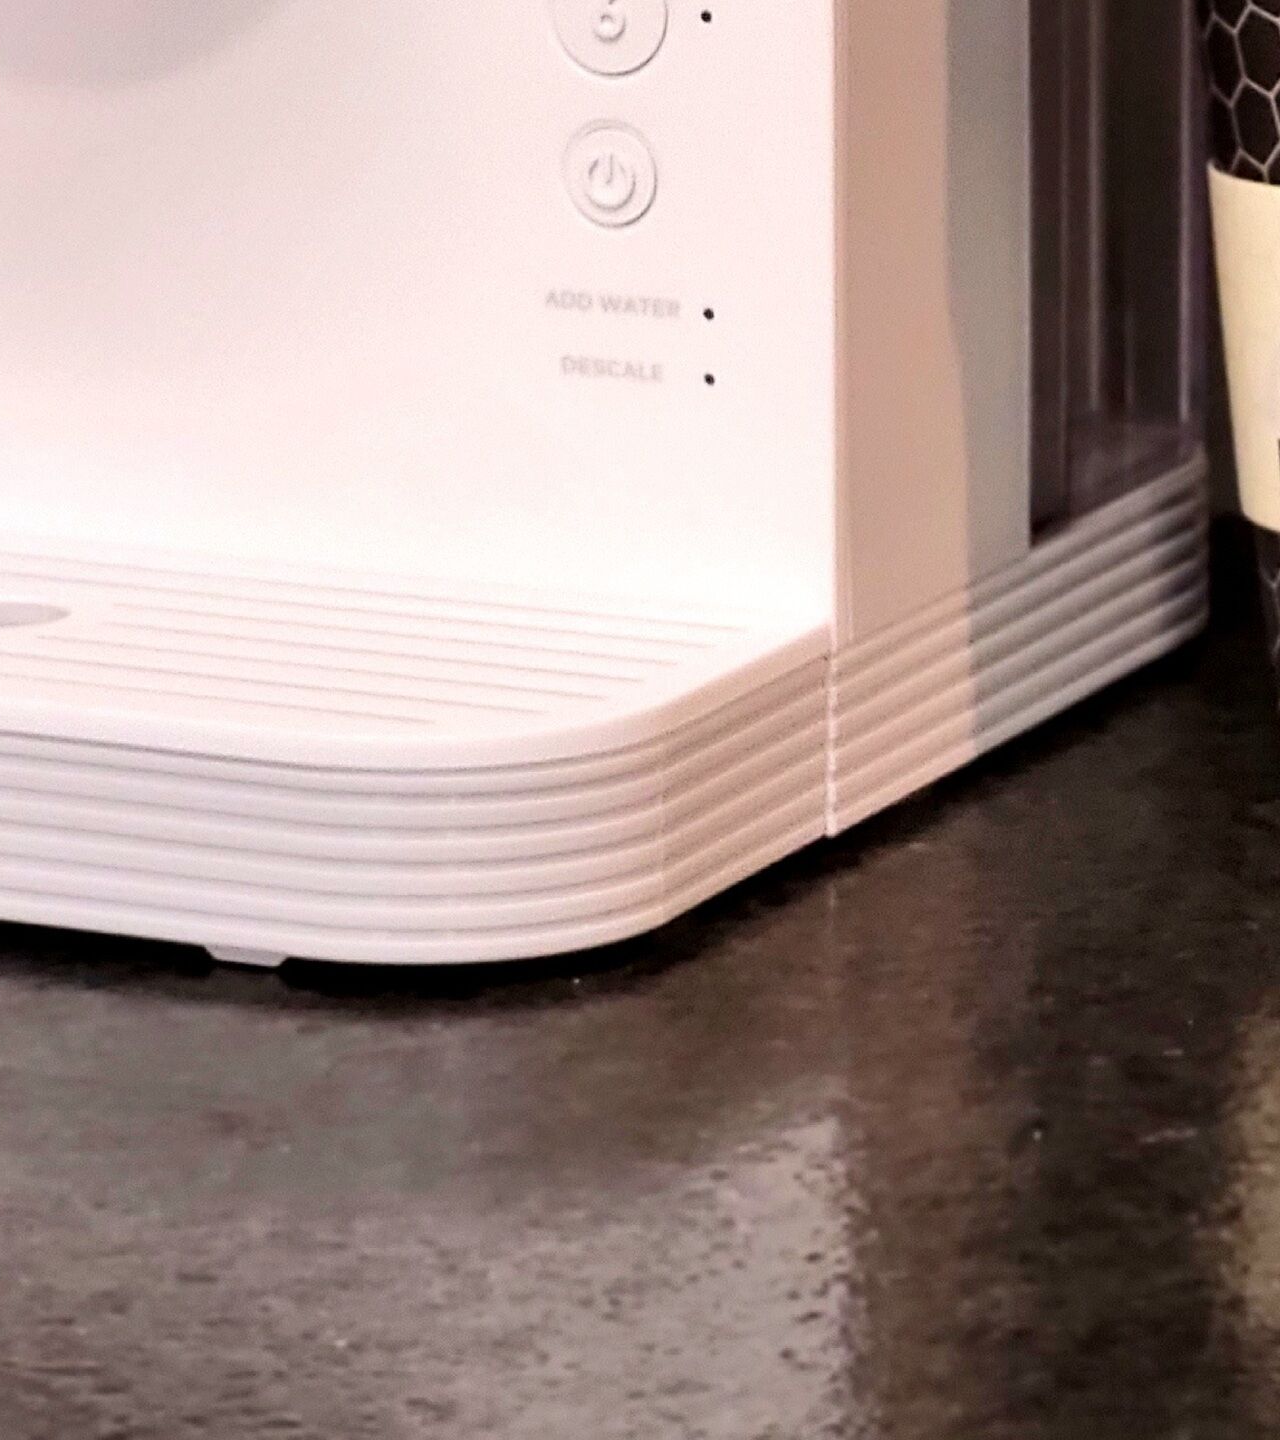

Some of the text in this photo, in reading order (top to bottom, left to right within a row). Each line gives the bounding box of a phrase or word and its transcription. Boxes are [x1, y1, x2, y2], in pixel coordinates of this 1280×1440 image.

[545, 289, 681, 319] ADD WATER
[560, 355, 664, 383] DESCALE
